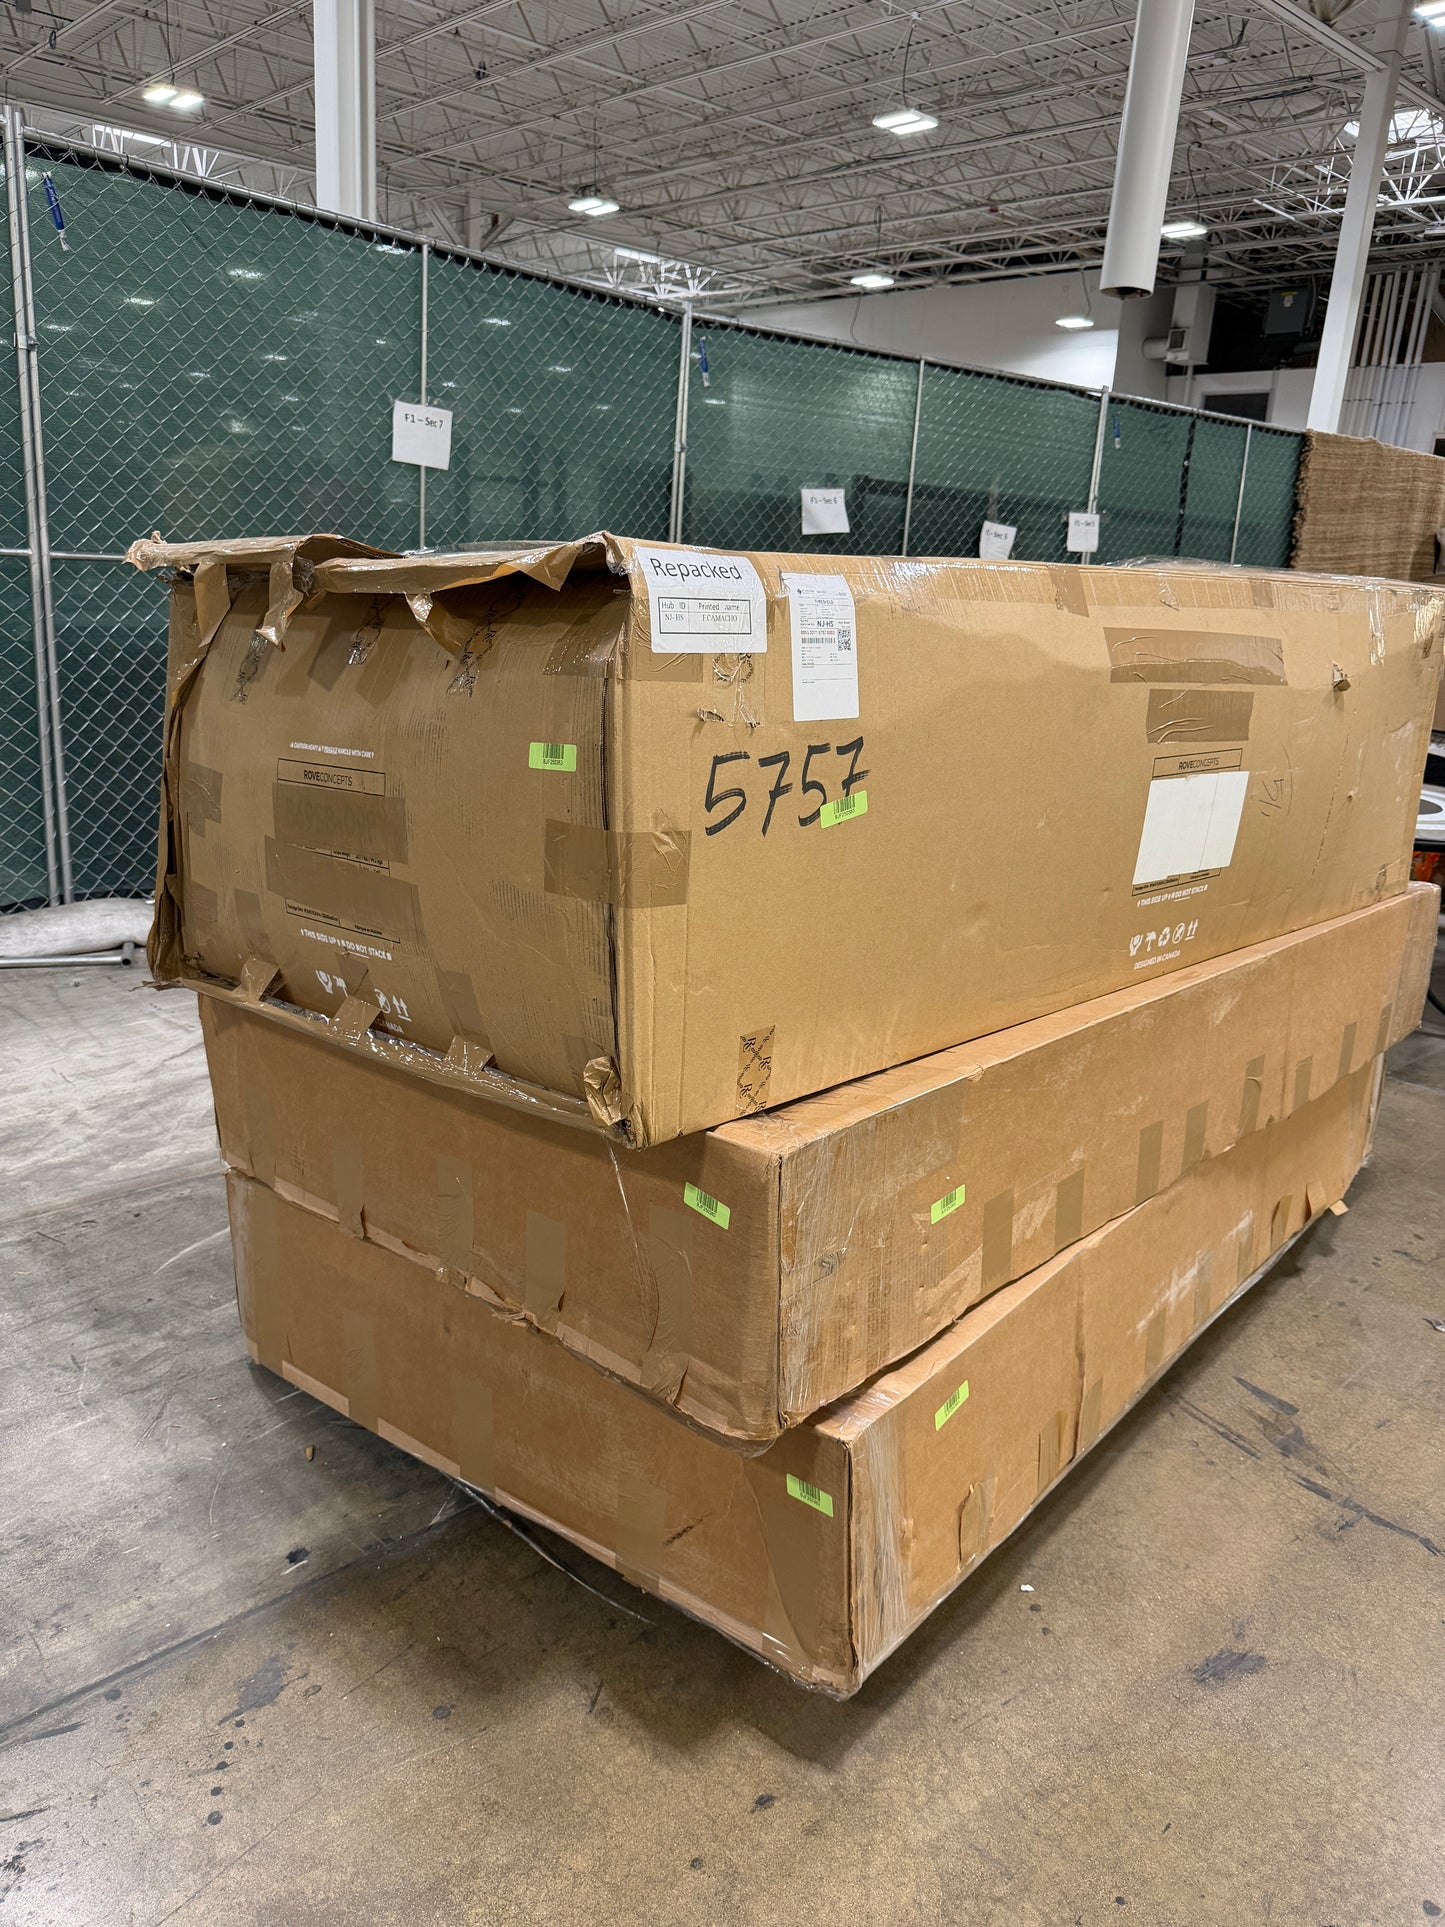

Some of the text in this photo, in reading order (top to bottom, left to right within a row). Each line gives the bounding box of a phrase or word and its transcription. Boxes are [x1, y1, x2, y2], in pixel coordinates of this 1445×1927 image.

[405, 413, 416, 423] F1
[425, 417, 438, 428] Sec
[439, 419, 444, 429] 7
[649, 557, 742, 582] Repacked
[661, 601, 686, 609] Hub ID
[698, 602, 720, 611] Printed
[817, 620, 834, 628] NJ-HS
[1178, 757, 1220, 771] ROVECONCEPTS
[303, 769, 353, 787] ROVECONCEPTS
[705, 736, 872, 838] 5757
[303, 928, 316, 939] THIS
[316, 932, 329, 943] SIDE
[328, 936, 337, 945] UP
[355, 943, 368, 954] NOT
[368, 946, 387, 960] STACK
[1133, 955, 1157, 970] DESIGNED
[1161, 950, 1181, 962] CANADA
